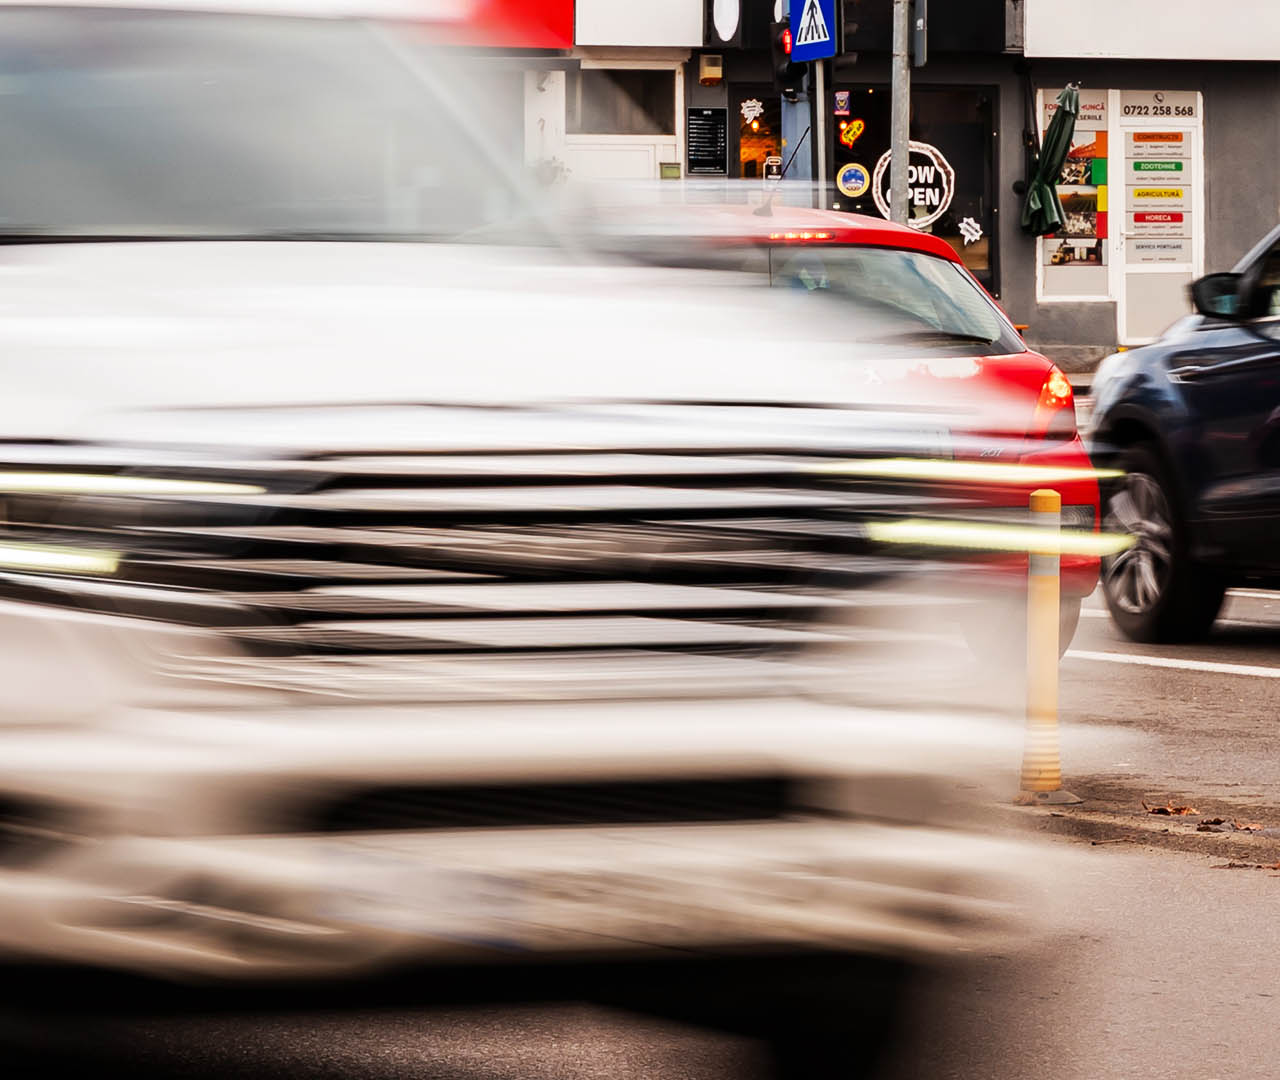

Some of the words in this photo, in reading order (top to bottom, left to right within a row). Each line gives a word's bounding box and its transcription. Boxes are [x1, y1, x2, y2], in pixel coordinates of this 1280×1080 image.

[1123, 105, 1149, 115] 0722
[1152, 105, 1171, 116] 258
[1174, 106, 1193, 116] 568
[979, 447, 1005, 457] 207
